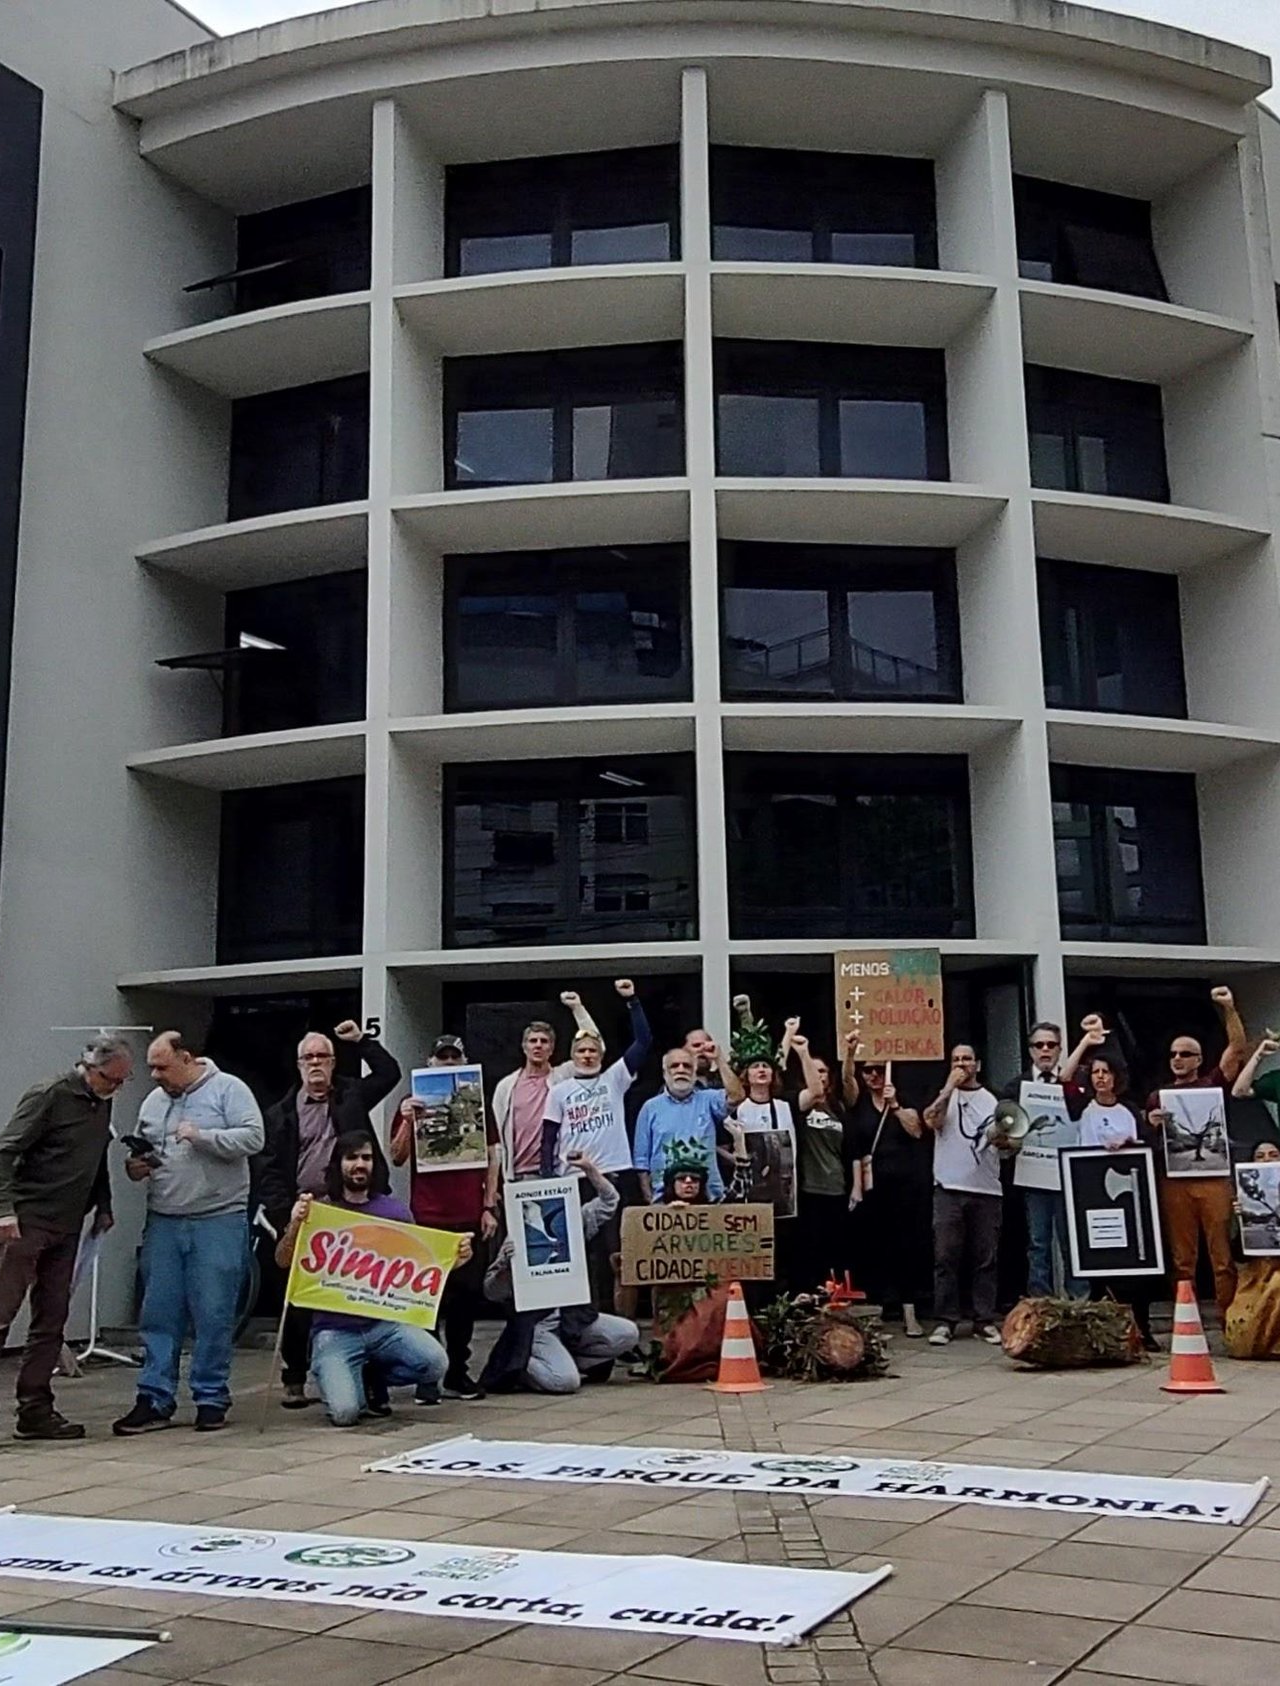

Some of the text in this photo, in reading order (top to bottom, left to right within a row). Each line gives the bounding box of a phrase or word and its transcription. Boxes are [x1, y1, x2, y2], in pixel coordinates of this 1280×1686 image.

[840, 962, 890, 977] MENOS
[366, 1017, 381, 1038] 5
[515, 1186, 572, 1199] AONDE ESTÃO?
[642, 1212, 758, 1233] CIDADE SEM
[300, 1231, 442, 1296] Simpa
[636, 1258, 704, 1281] CIDADE
[543, 1465, 754, 1484] PARQUE
[767, 1476, 841, 1489] DA
[866, 1481, 1230, 1518] HARMONIA!
[89, 1565, 153, 1579] as
[150, 1566, 333, 1594] árvores
[329, 1582, 429, 1602] não
[437, 1592, 585, 1623] corta,
[609, 1606, 796, 1632] cuida!
